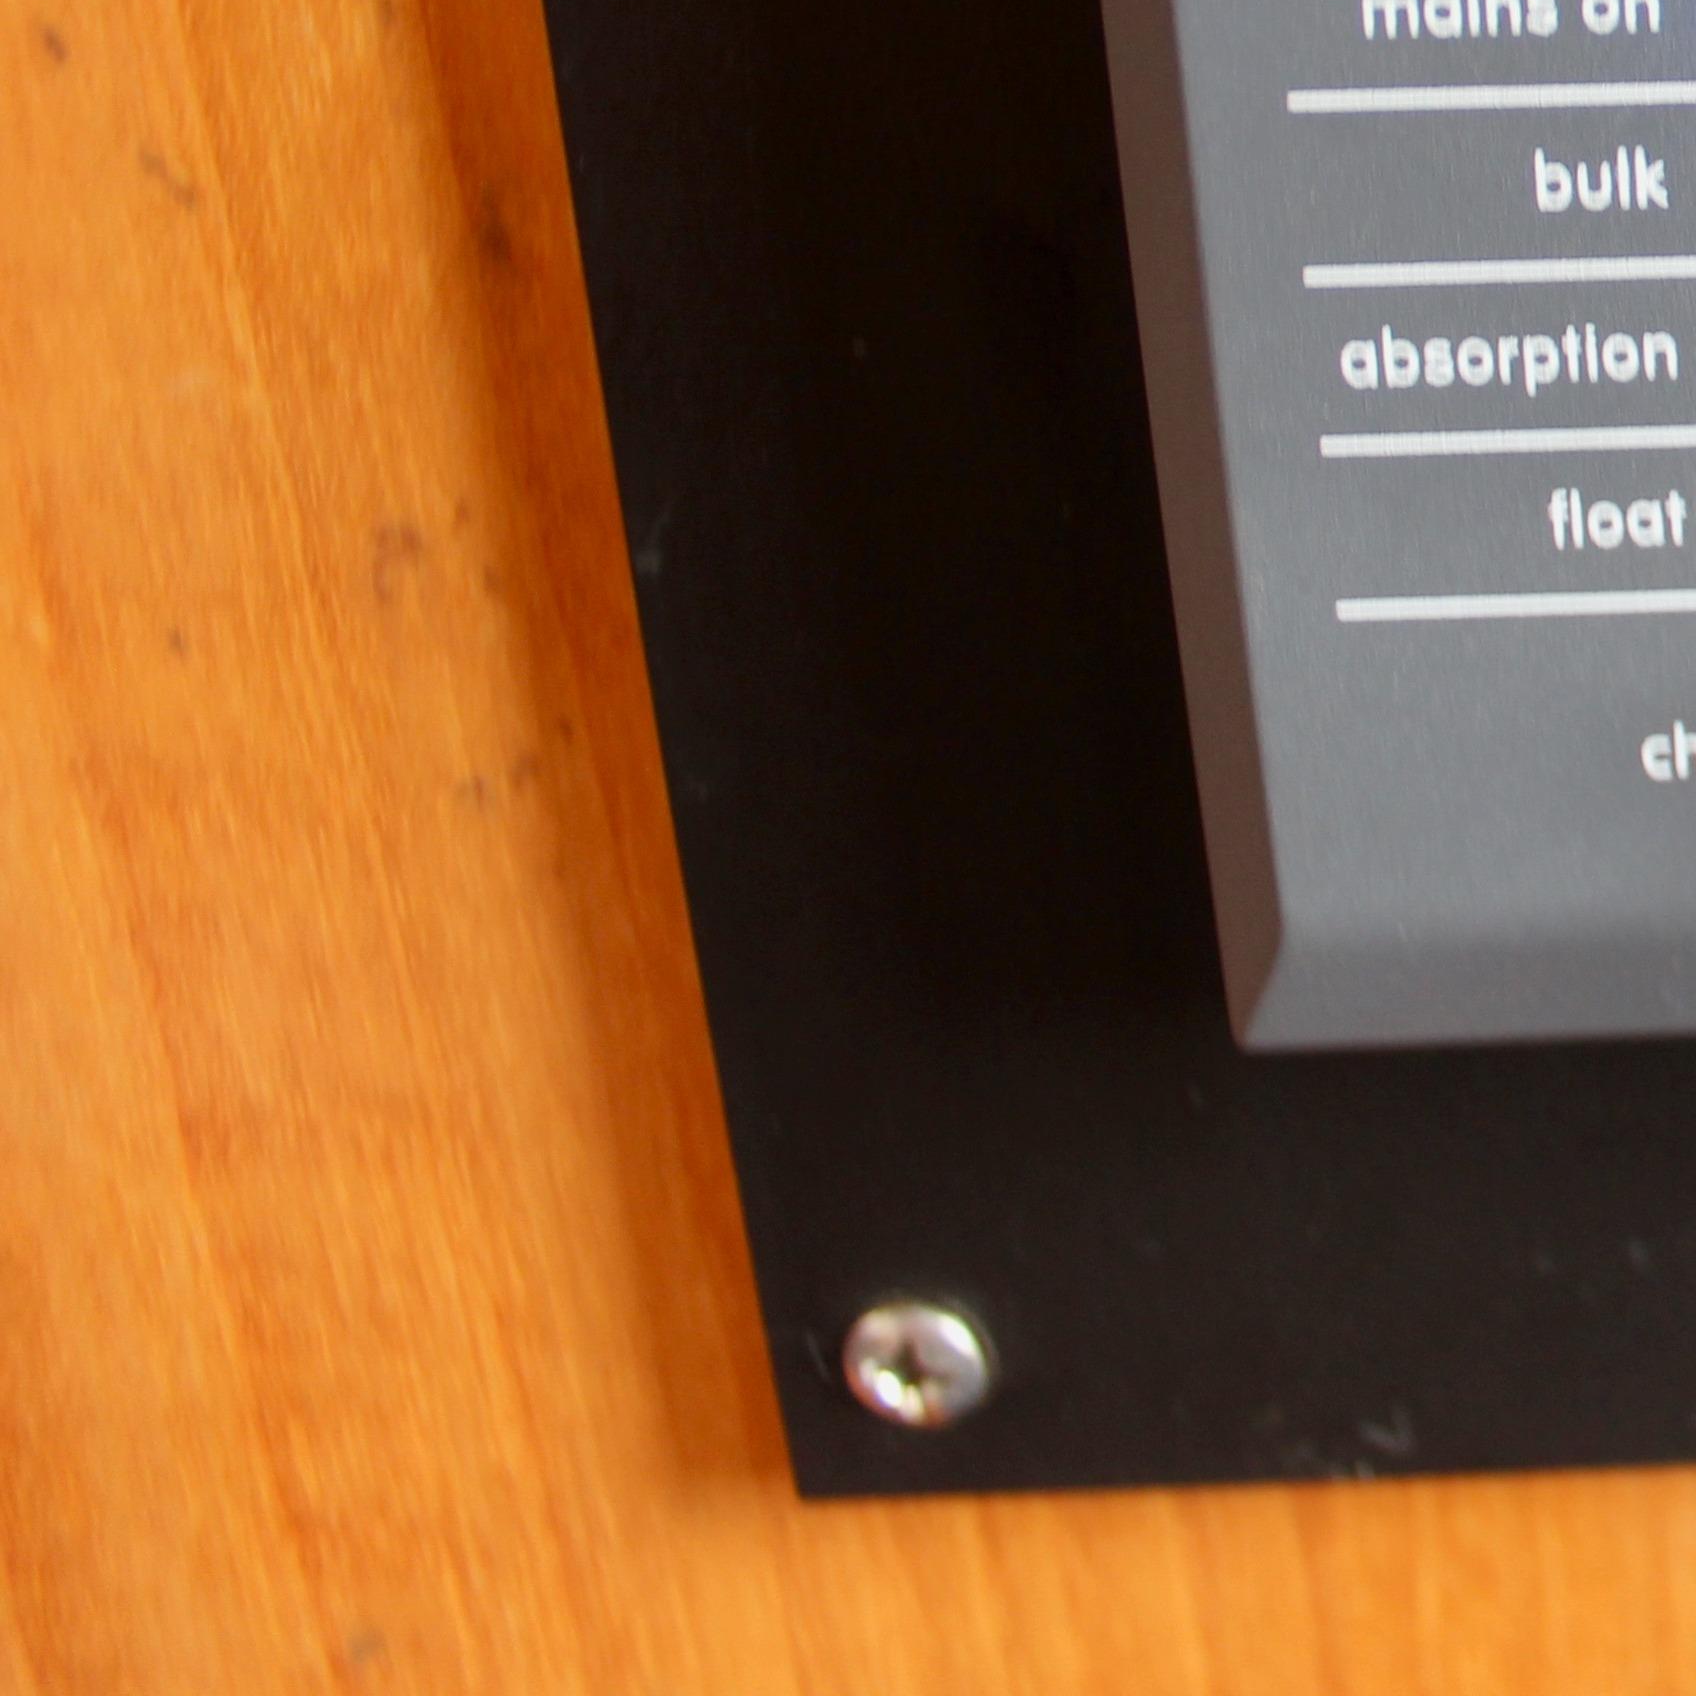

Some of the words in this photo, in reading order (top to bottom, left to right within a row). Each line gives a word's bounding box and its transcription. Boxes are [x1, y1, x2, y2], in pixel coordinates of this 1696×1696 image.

[1533, 144, 1670, 212] bulk
[1340, 321, 1678, 397] absorption
[1549, 486, 1687, 551] float
